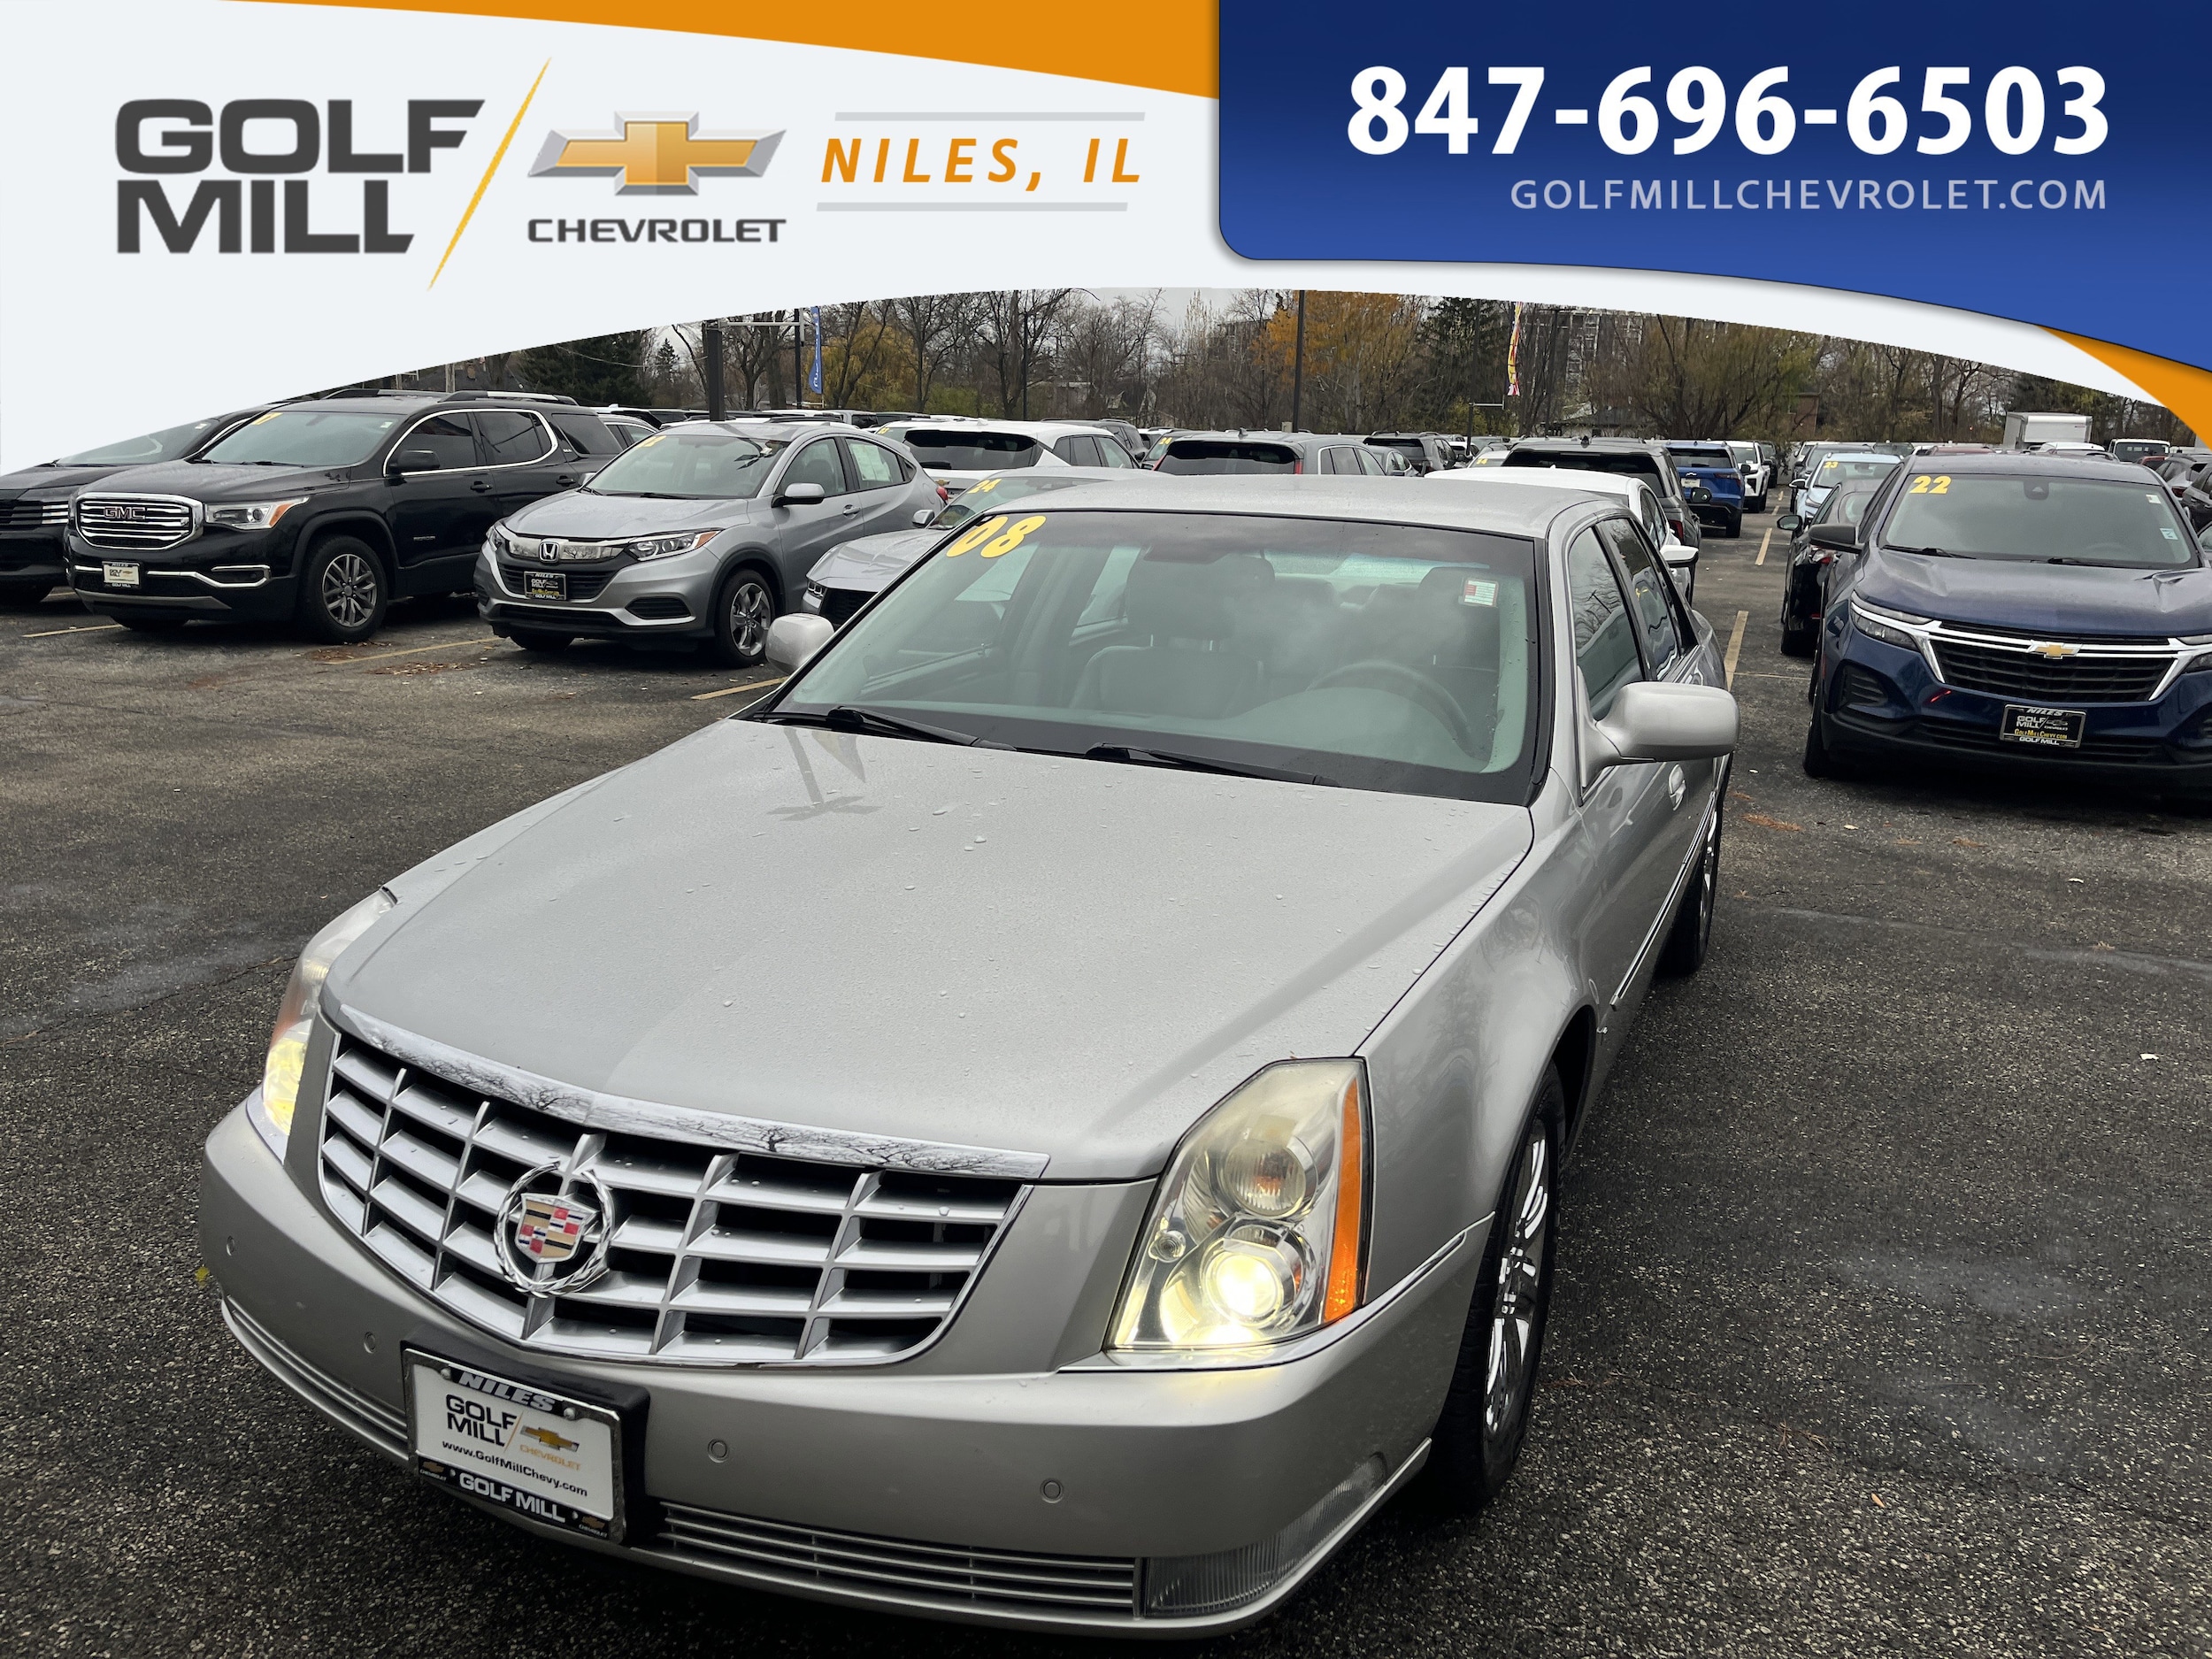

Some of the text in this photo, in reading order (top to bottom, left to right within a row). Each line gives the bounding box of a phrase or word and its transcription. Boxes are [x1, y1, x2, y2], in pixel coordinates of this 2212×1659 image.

[966, 479, 1002, 494] 24
[1909, 475, 1952, 495] 22
[104, 506, 146, 519] GMC
[946, 516, 1047, 558] 08
[458, 1371, 555, 1412] NILES
[446, 1394, 517, 1430] GOLF
[447, 1411, 505, 1448] MILL
[442, 1440, 588, 1497] www.GolfMillChevy.com
[459, 1472, 565, 1523] GOLF MILL
